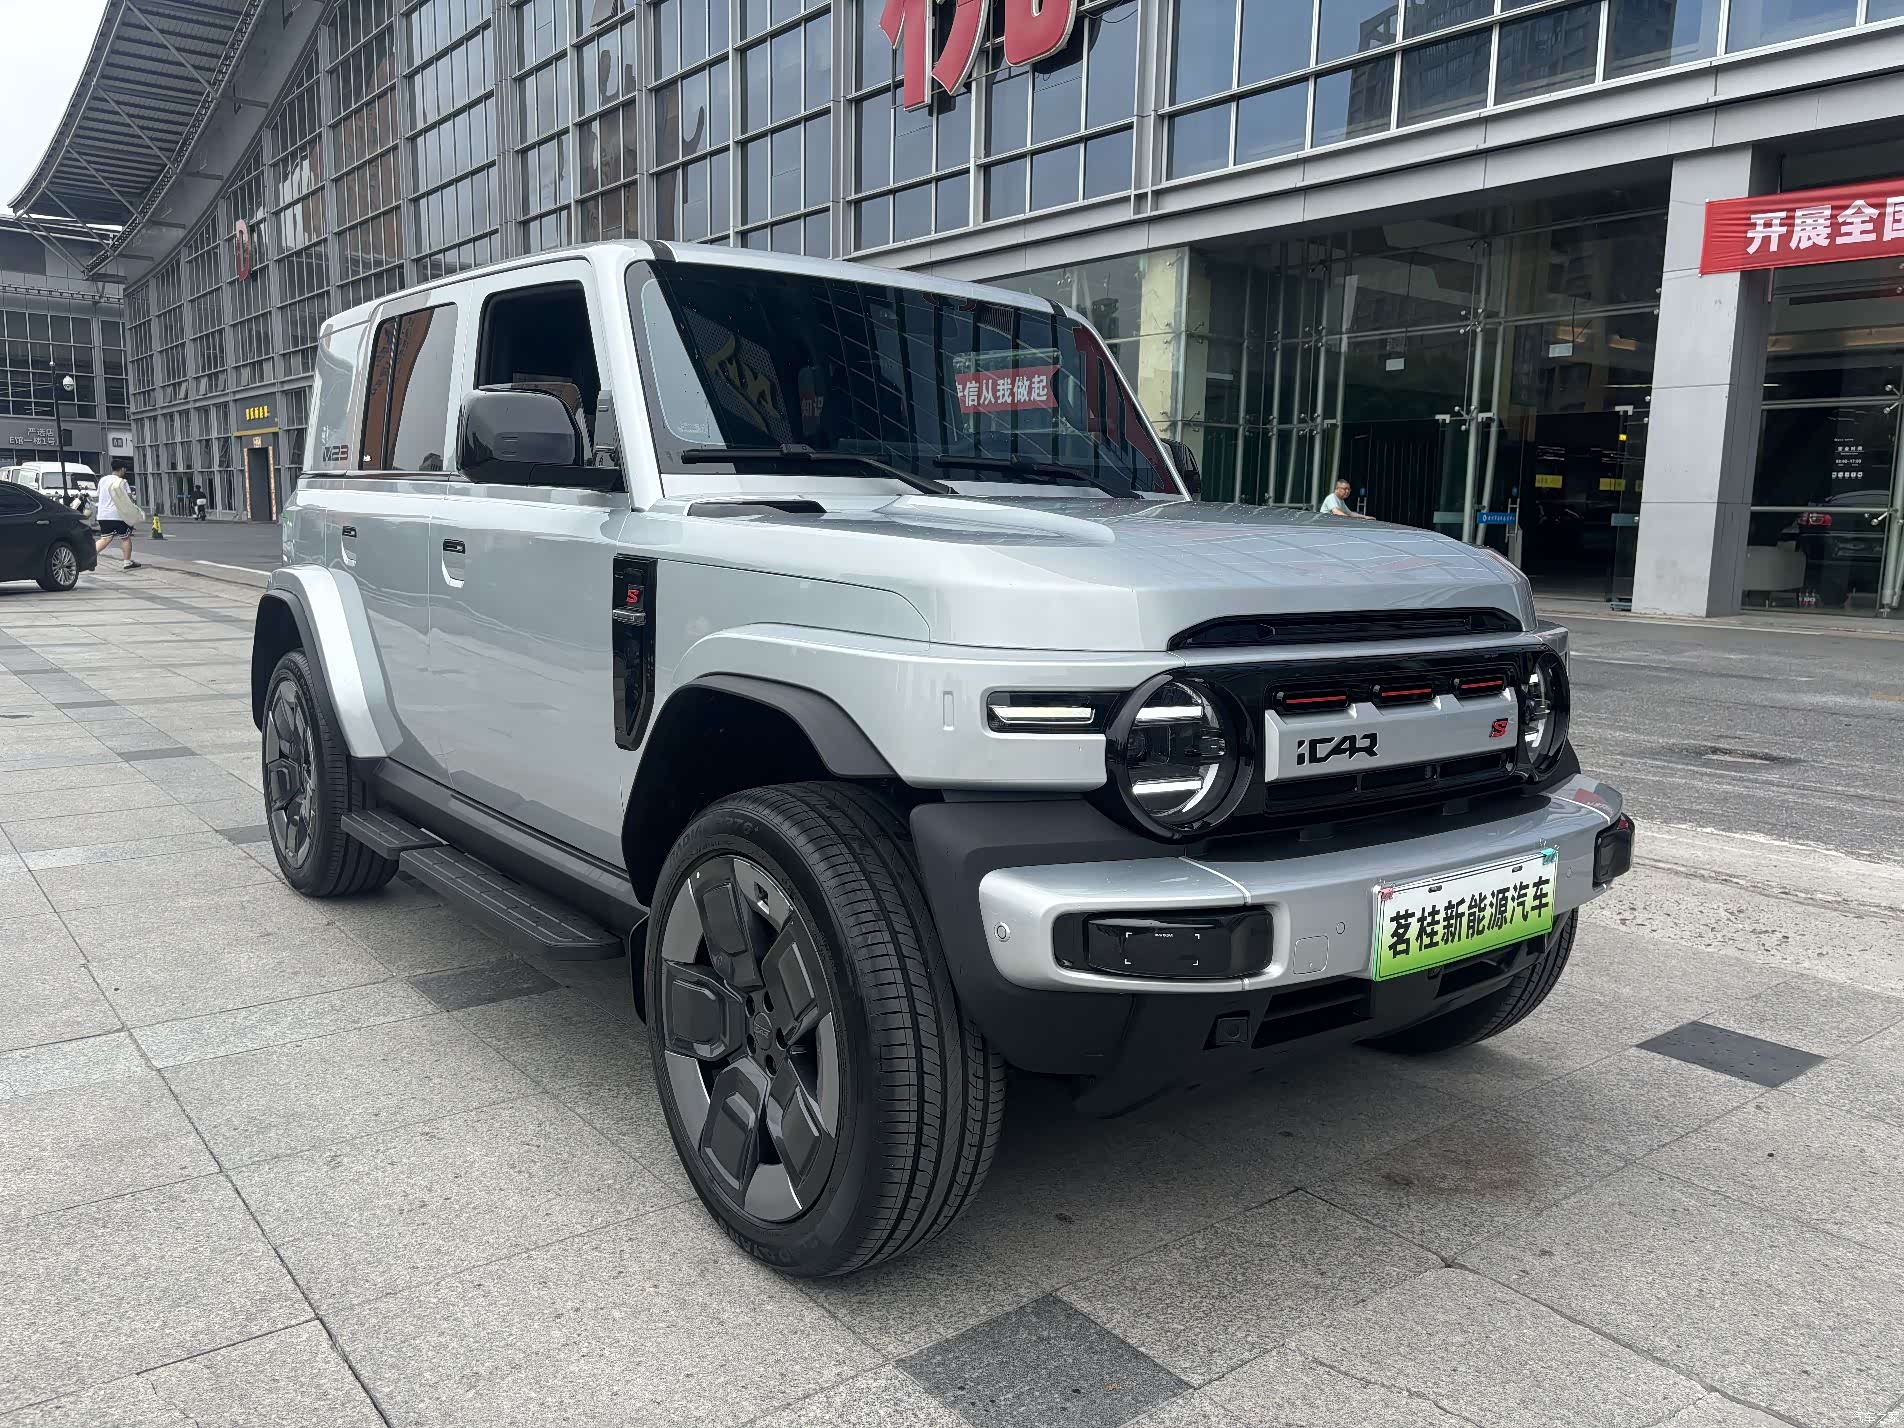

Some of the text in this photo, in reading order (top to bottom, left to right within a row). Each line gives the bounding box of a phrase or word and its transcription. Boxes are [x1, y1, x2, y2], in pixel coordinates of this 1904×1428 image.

[9, 436, 59, 446] E馆一楼1号
[626, 589, 639, 603] S
[1489, 718, 1508, 738] S
[1387, 876, 1550, 958] 茗桂新能源汽车
